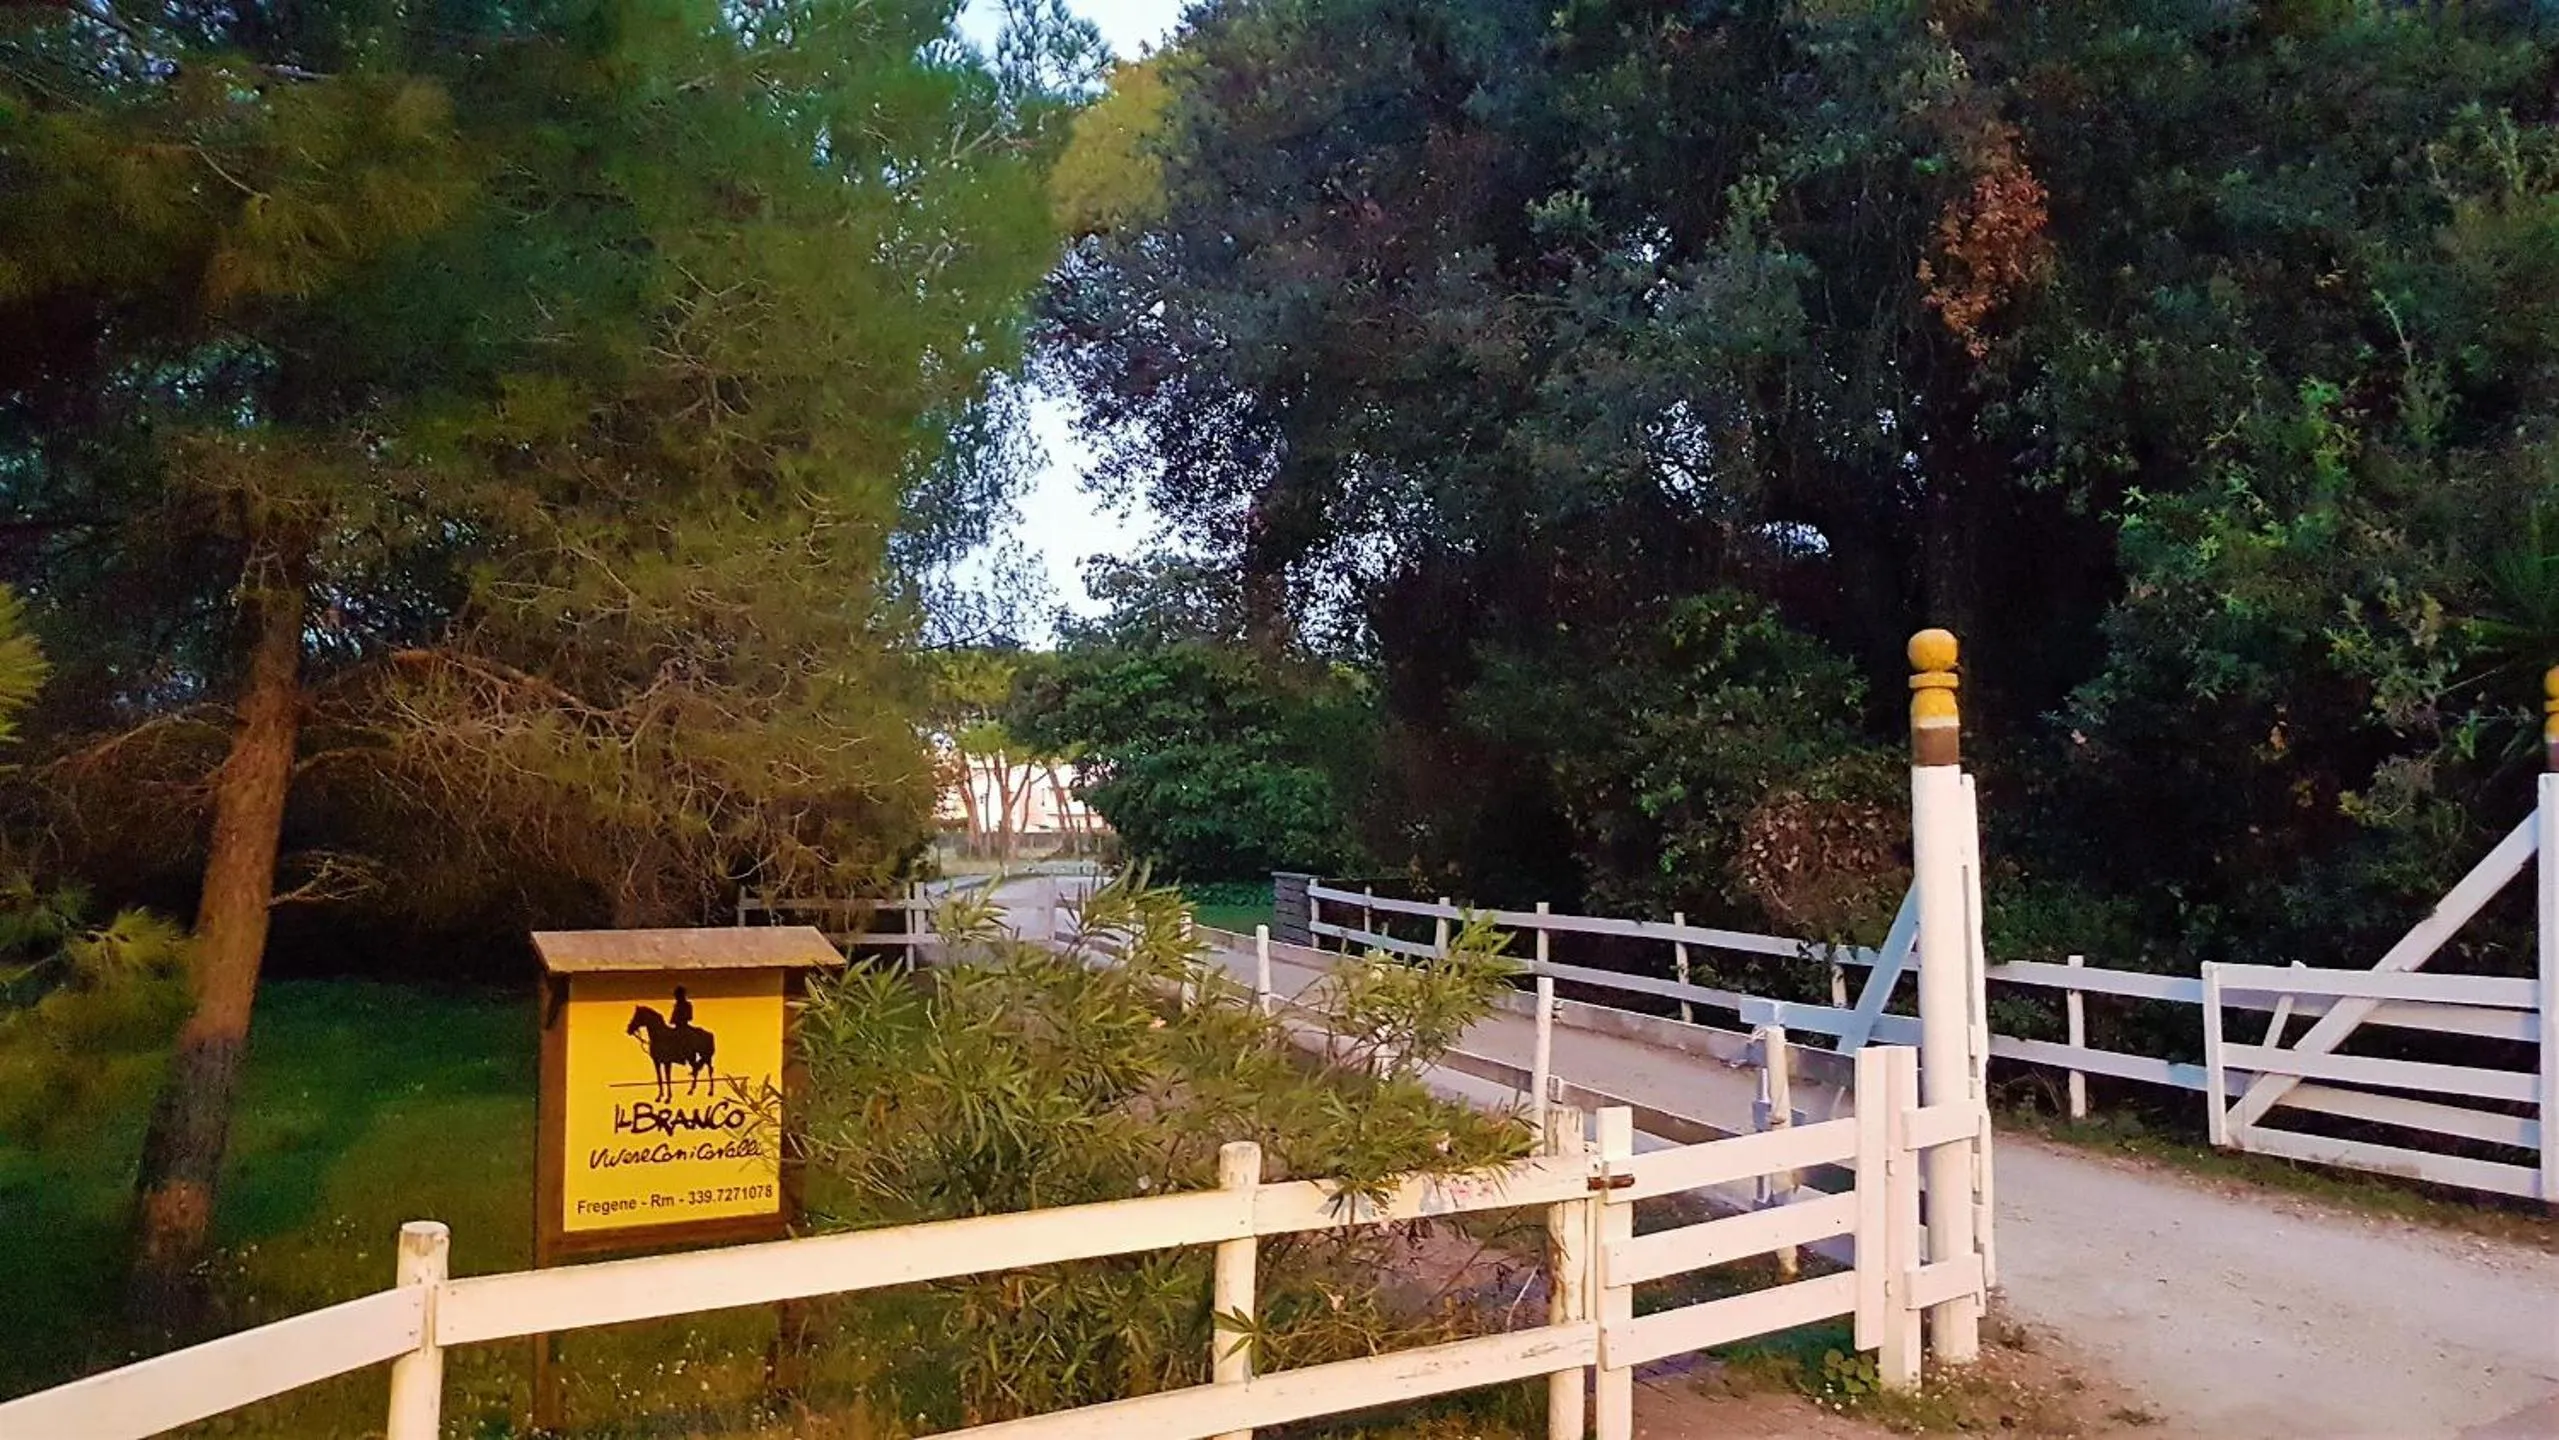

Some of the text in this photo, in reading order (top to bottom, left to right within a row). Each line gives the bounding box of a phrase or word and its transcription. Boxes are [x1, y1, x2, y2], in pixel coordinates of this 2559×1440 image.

[577, 1199, 637, 1216] Fregene
[651, 1193, 675, 1209] Rm
[688, 1184, 773, 1206] 339.7271078
